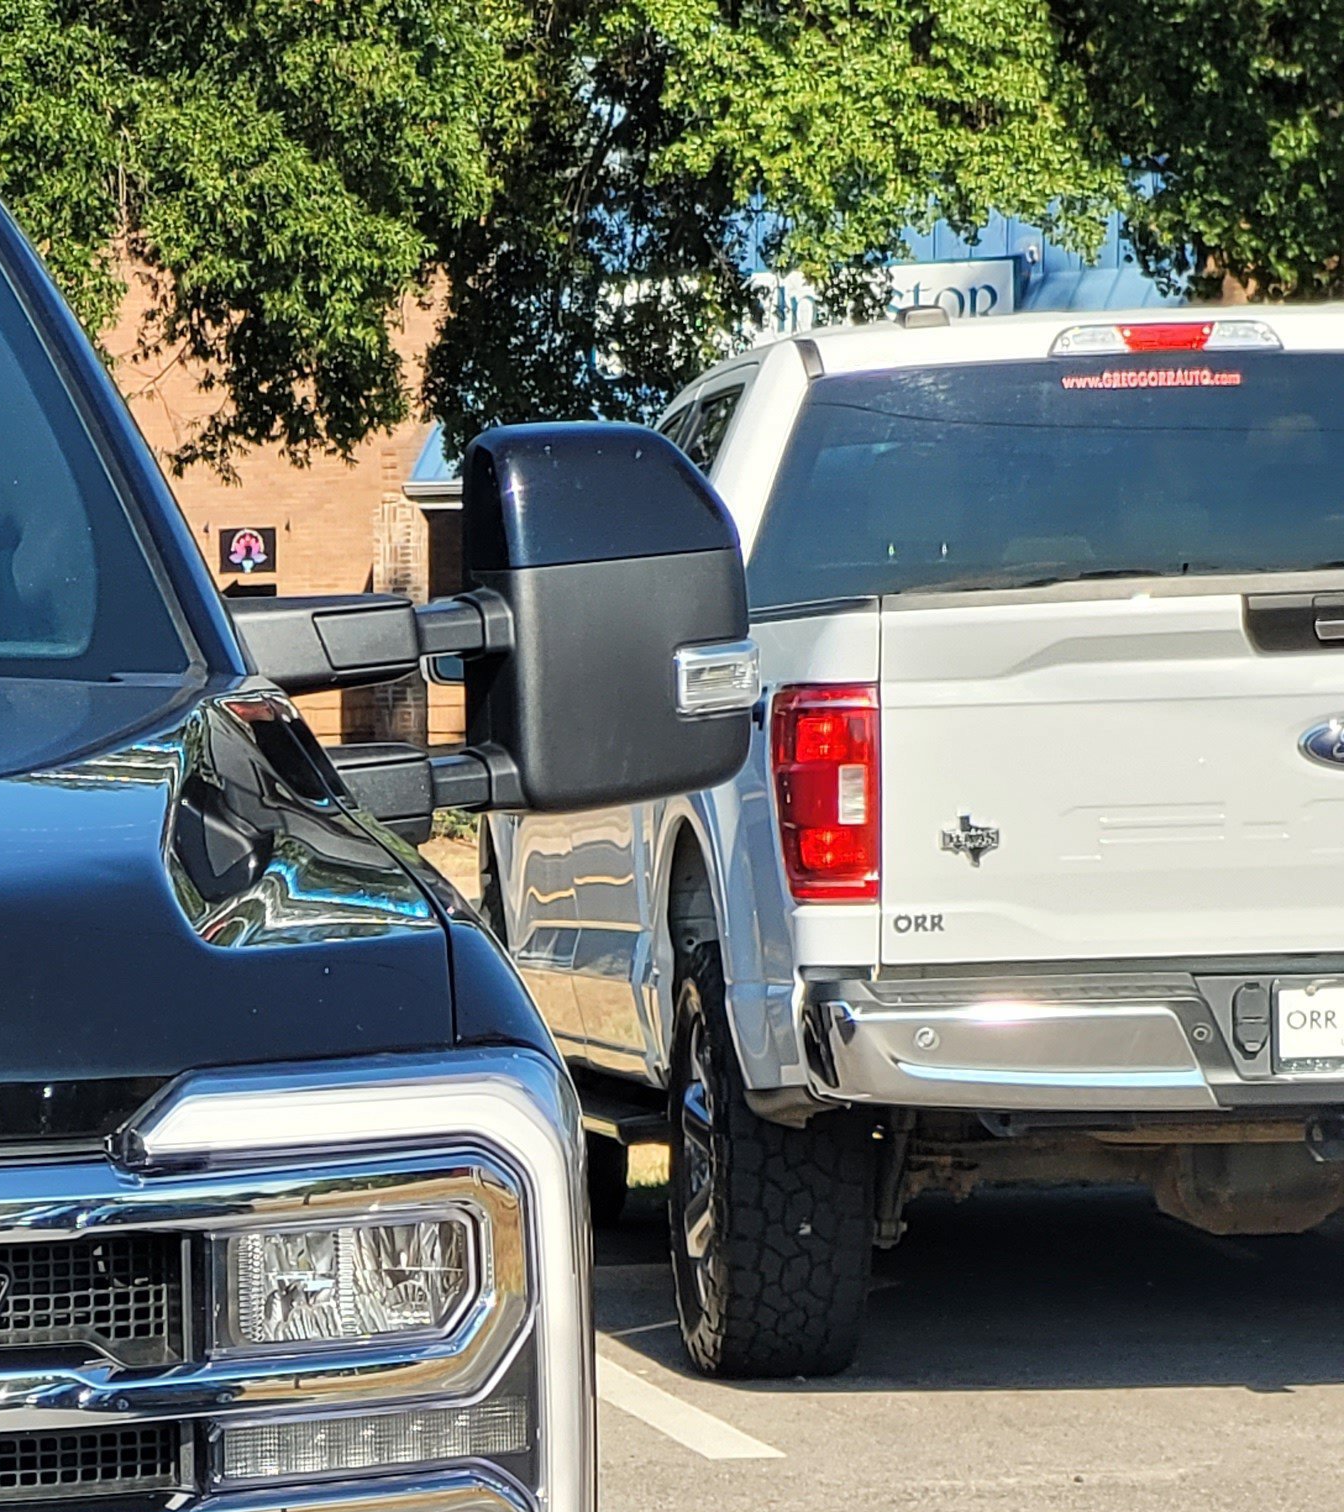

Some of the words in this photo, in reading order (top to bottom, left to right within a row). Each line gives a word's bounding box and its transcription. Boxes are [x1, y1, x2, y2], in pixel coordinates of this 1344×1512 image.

[1062, 369, 1241, 389] www.GREGGORRAUTO.com
[893, 913, 944, 933] ORR
[1287, 1010, 1337, 1029] ORR
